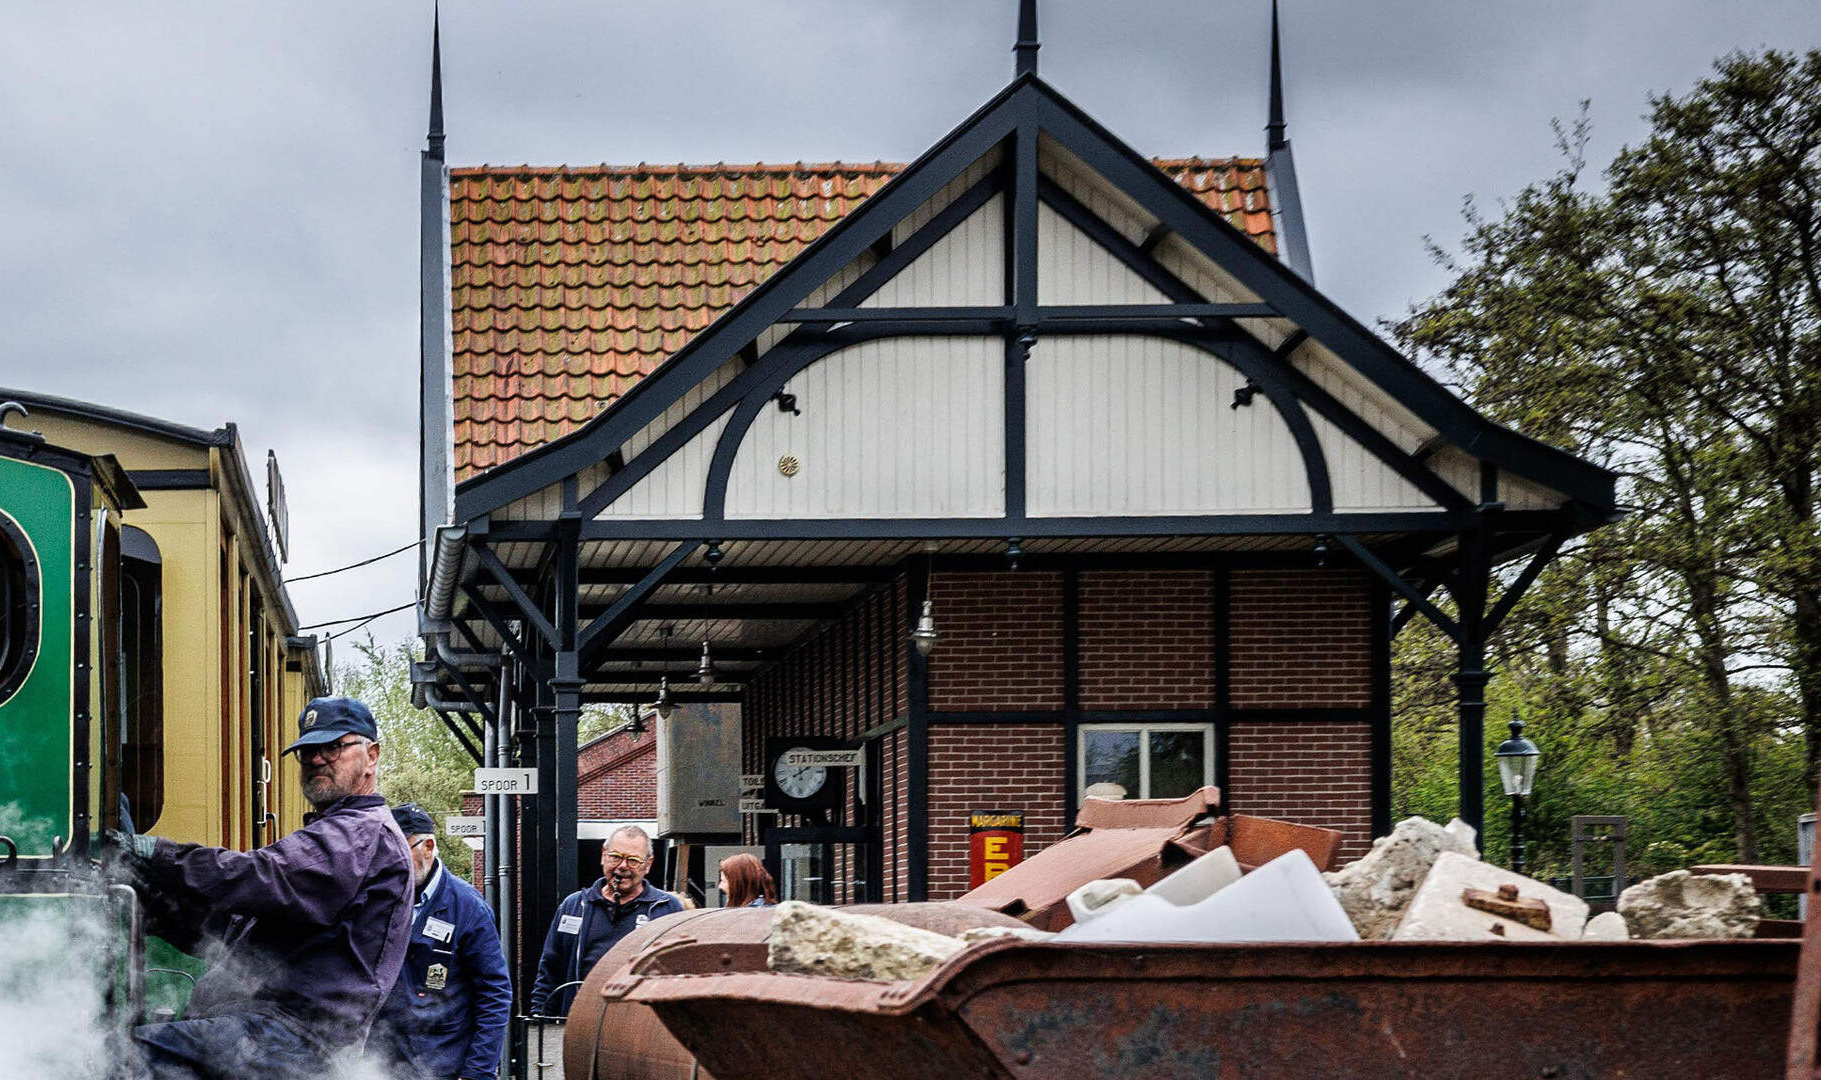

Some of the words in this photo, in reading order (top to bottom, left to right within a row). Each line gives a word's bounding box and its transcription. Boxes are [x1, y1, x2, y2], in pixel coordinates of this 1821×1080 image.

[788, 753, 858, 764] STATIONSCHEF
[481, 780, 518, 791] SPOOR
[524, 774, 530, 790] 1
[971, 815, 1022, 827] MARGARINE
[450, 825, 478, 833] SPOOR
